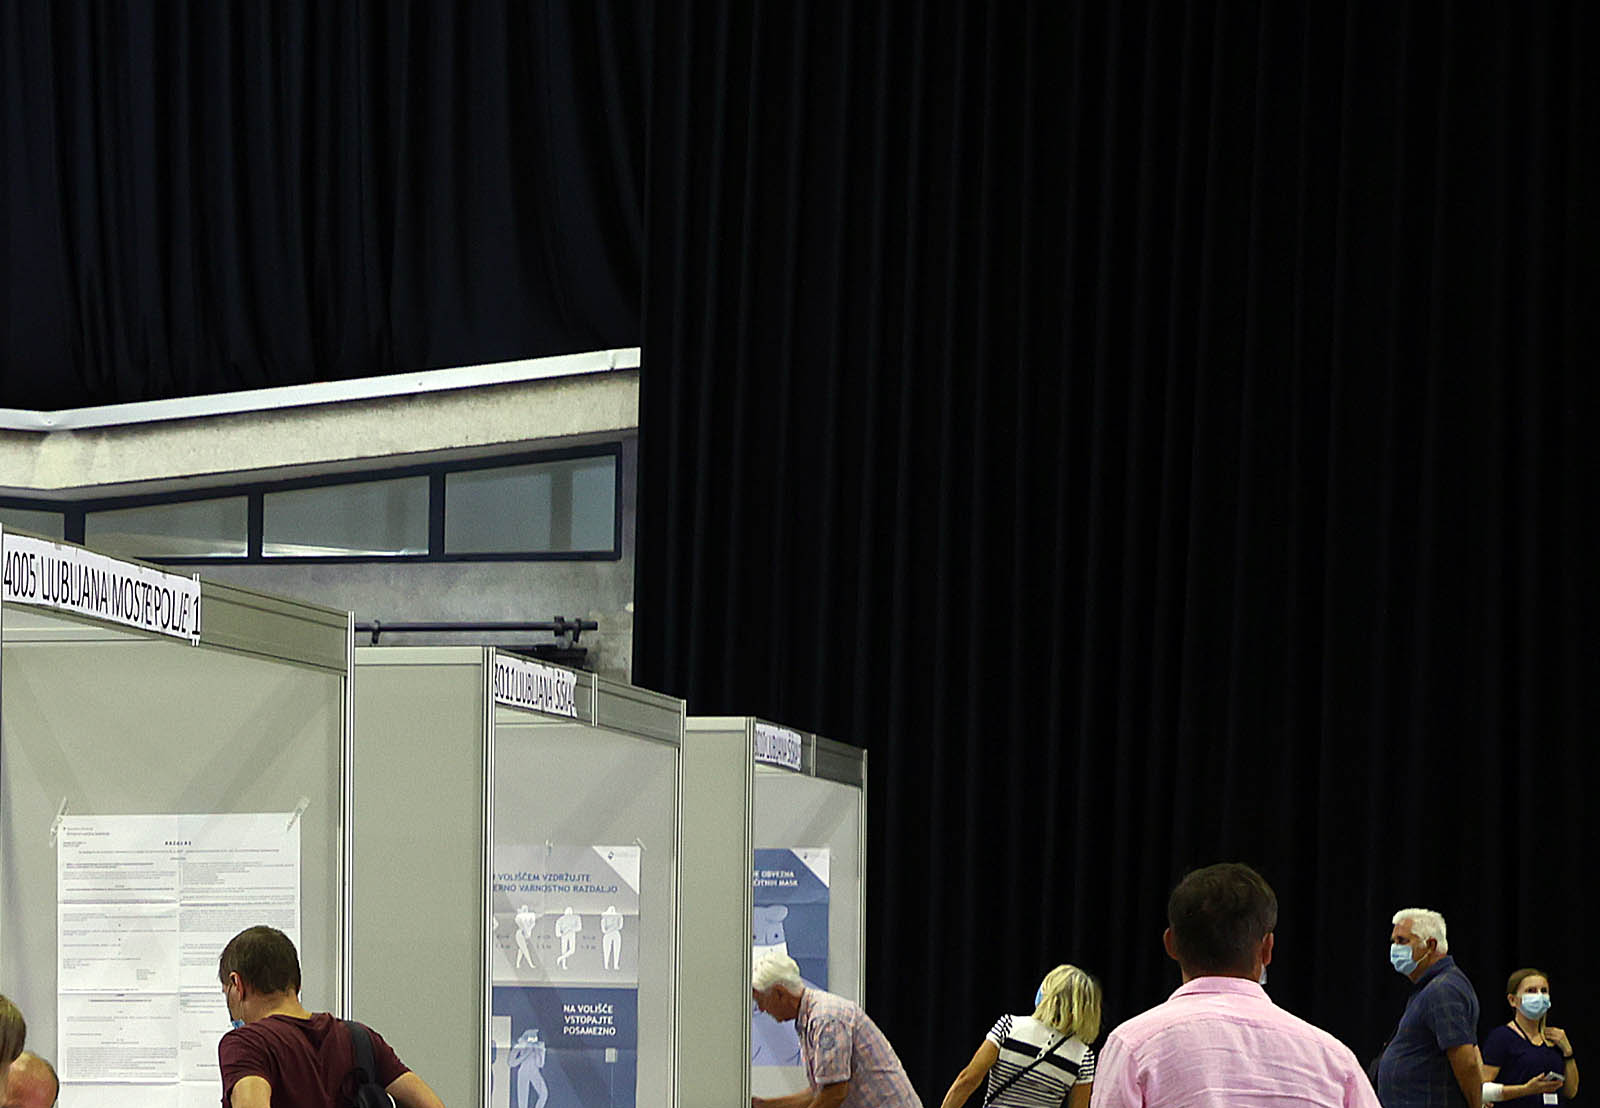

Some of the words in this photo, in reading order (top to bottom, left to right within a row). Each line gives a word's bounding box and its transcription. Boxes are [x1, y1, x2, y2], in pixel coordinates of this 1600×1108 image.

[4, 550, 37, 598] 4005
[41, 555, 109, 615] LJUBLJANA
[191, 595, 201, 635] 1
